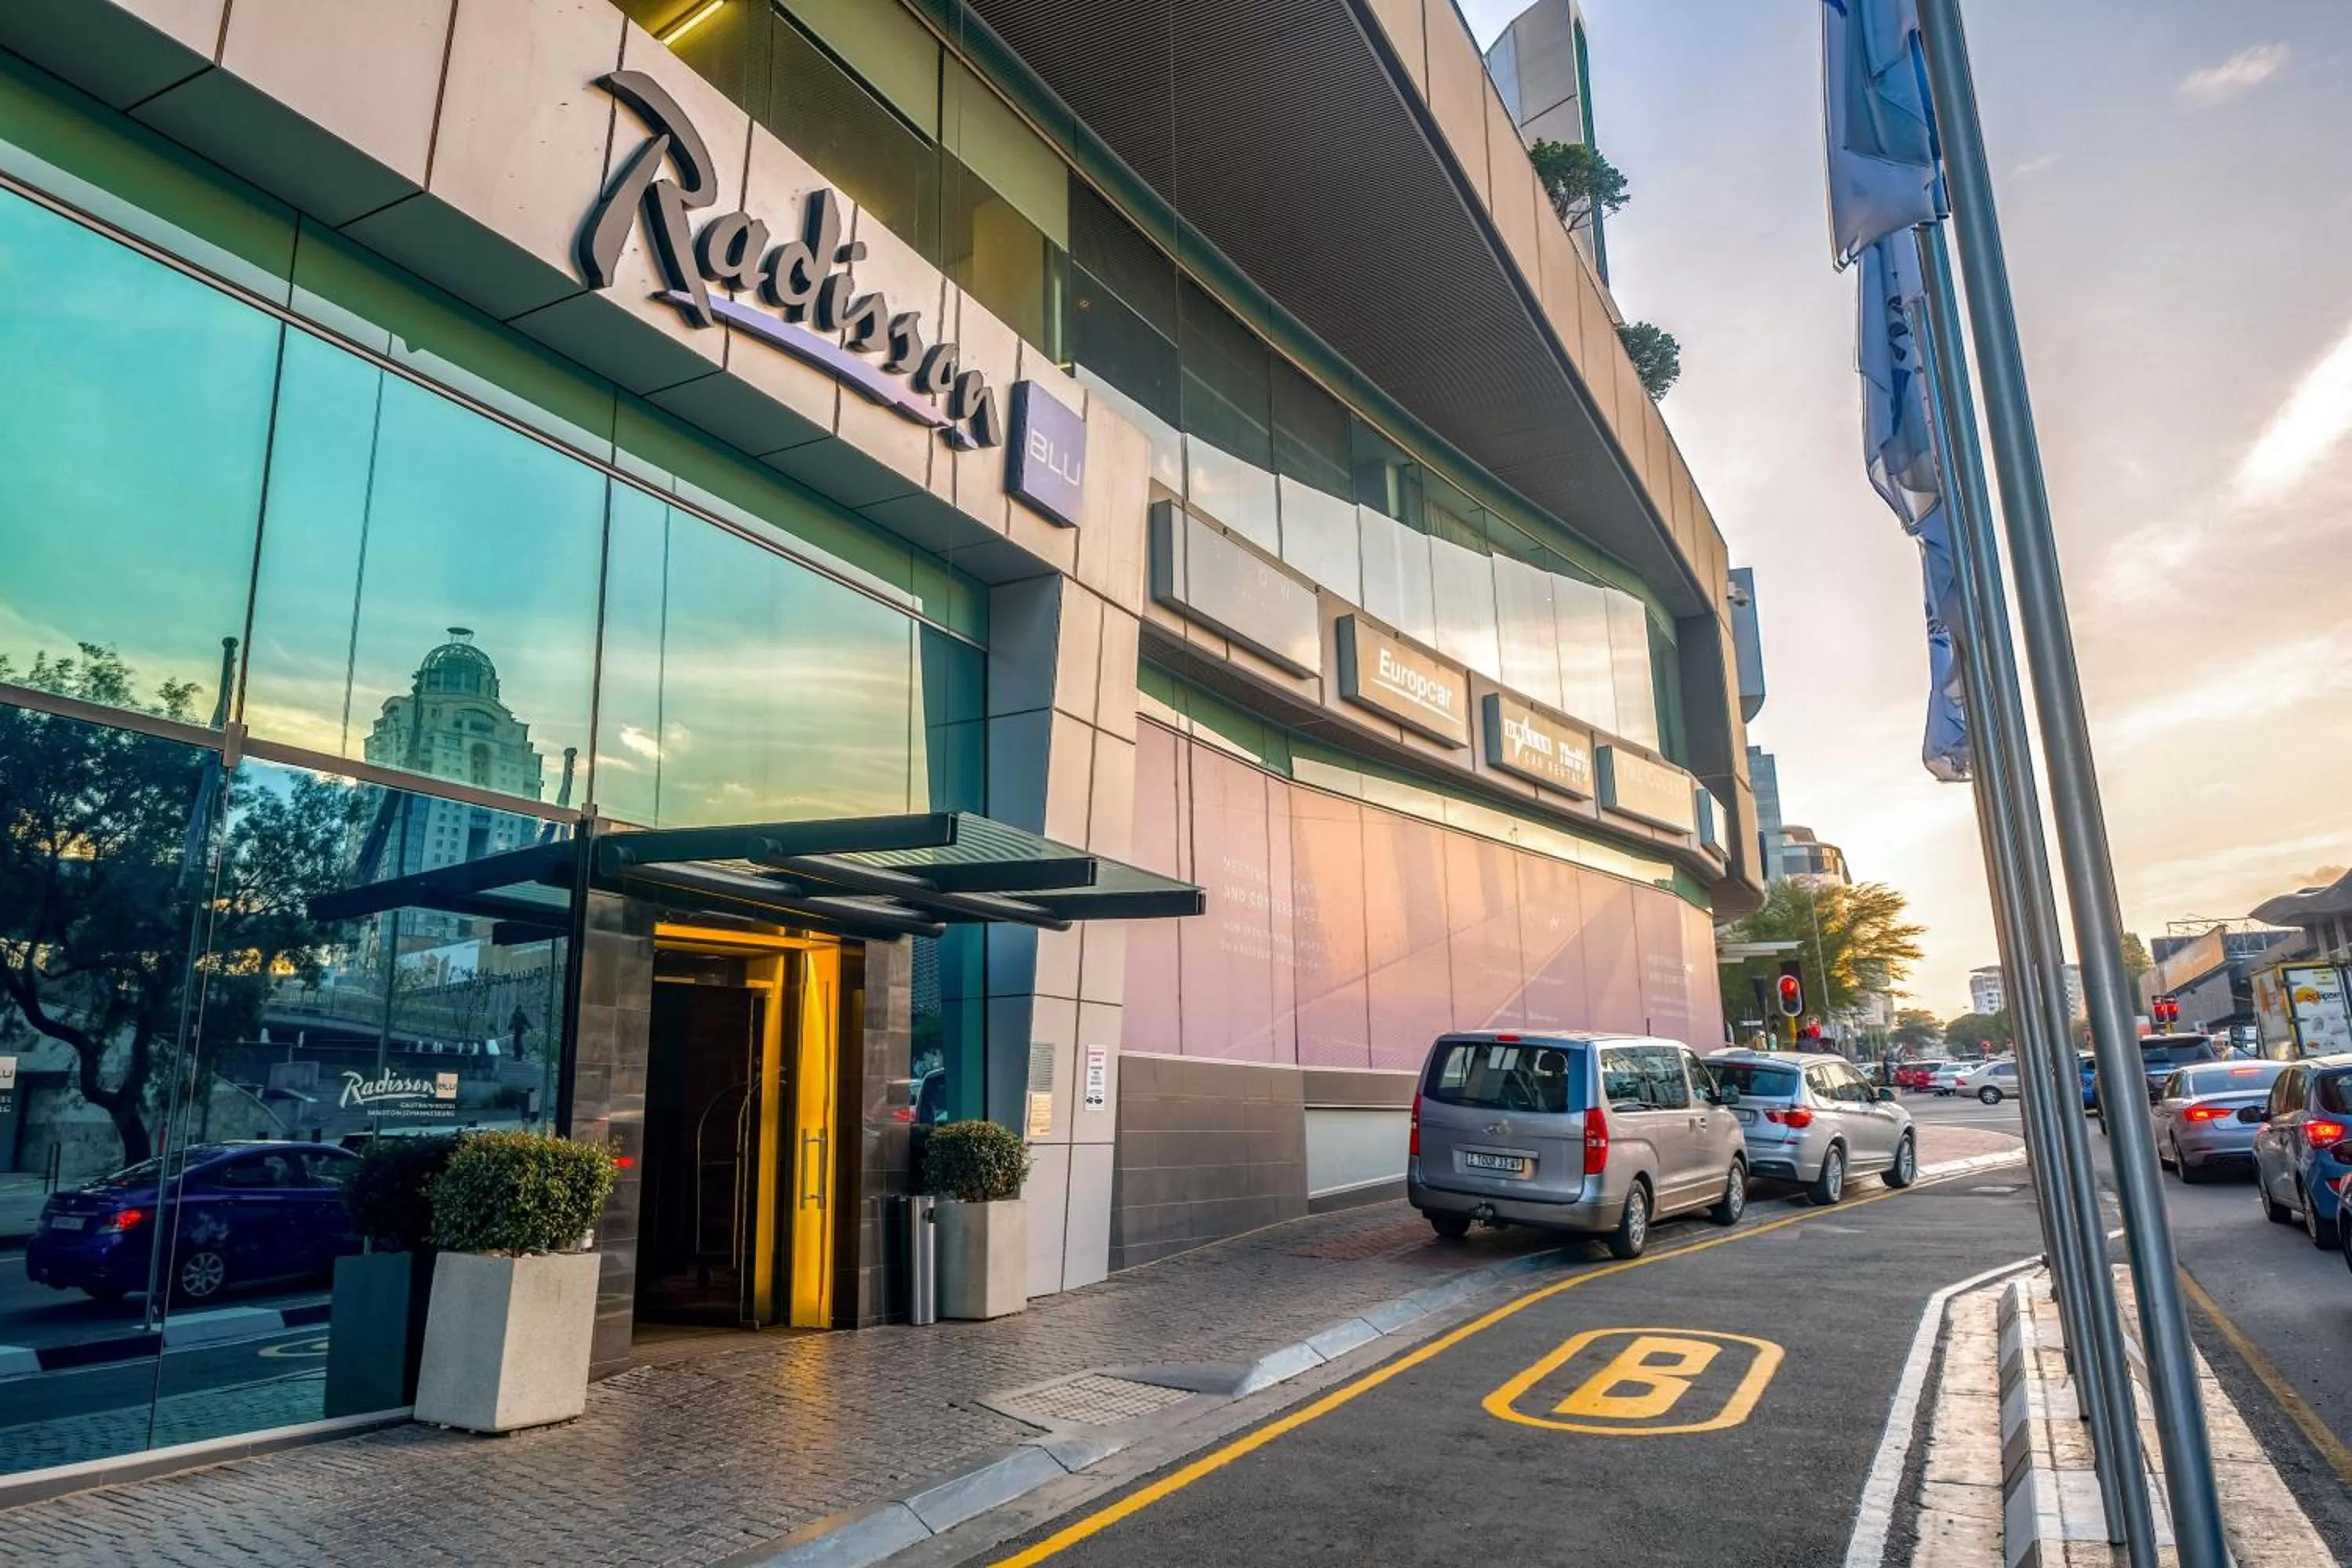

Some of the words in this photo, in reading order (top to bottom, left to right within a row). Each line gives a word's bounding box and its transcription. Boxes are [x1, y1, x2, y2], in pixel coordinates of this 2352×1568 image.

[573, 70, 1002, 448] Radisson
[1029, 427, 1081, 486] BLU
[1380, 648, 1453, 710] Europcar
[339, 1067, 434, 1109] Radisson
[1551, 1335, 1724, 1419] B
